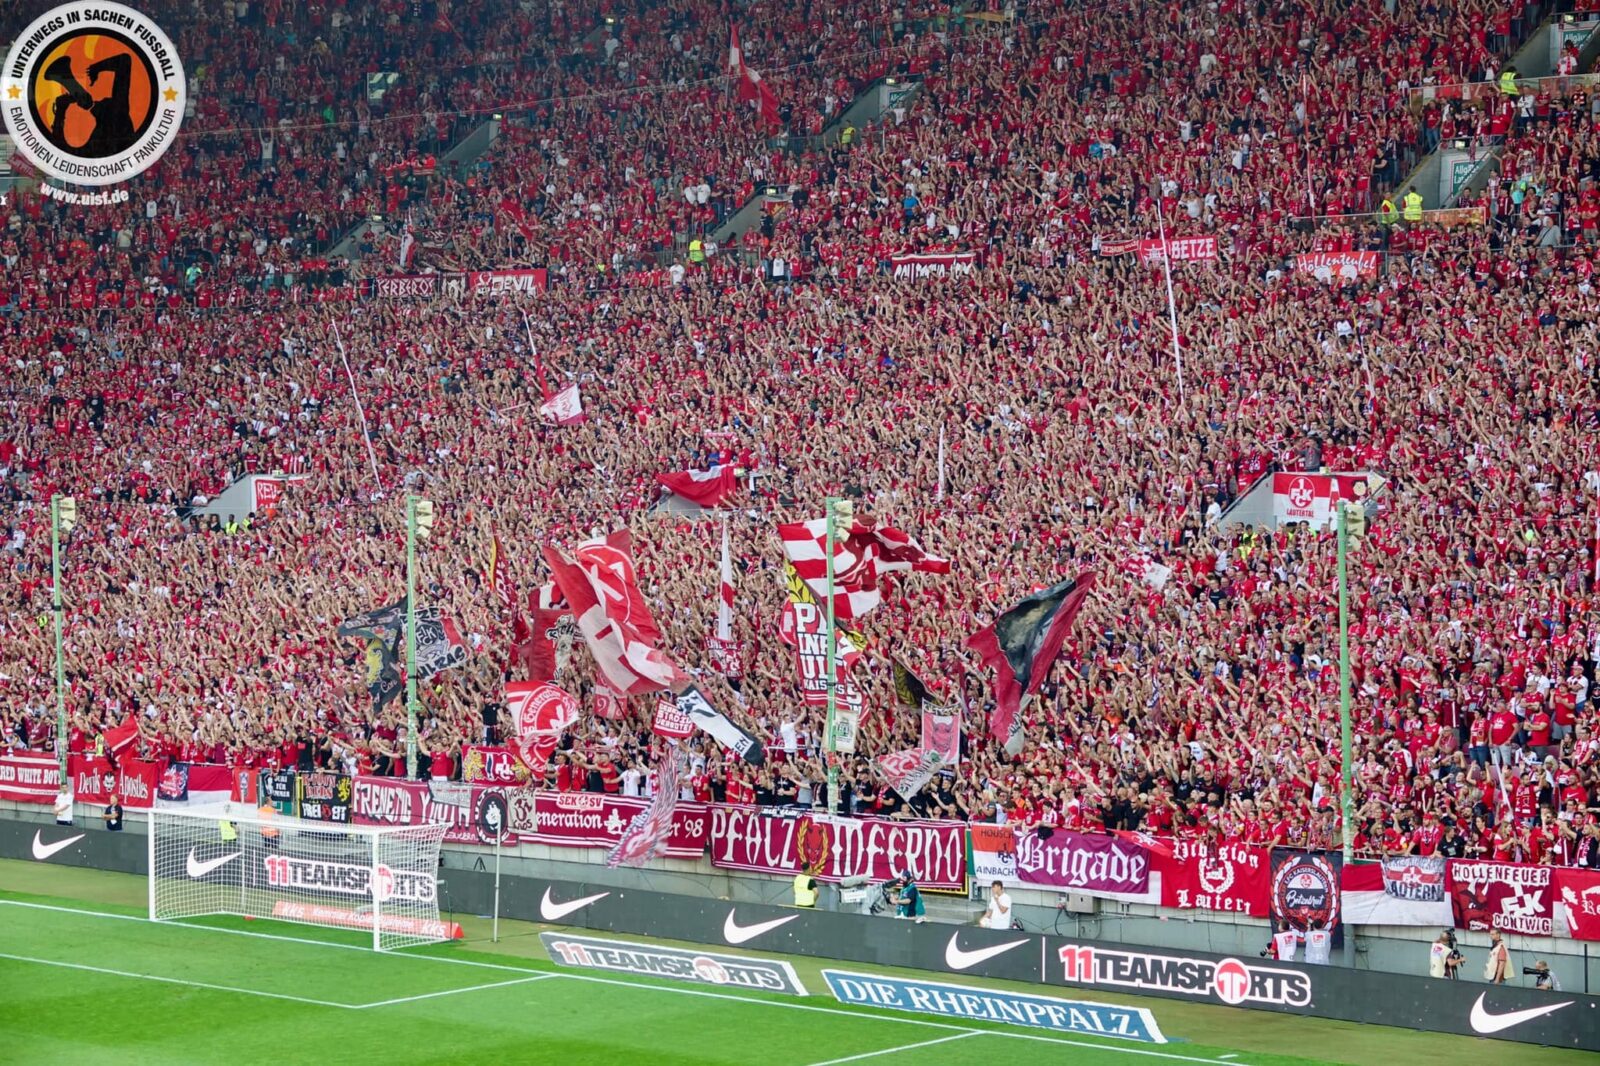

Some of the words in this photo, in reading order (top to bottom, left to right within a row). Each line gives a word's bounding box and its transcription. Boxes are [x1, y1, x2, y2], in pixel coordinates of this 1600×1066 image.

[1171, 238, 1214, 260] BETZE
[1297, 251, 1376, 272] Höllenteufel
[17, 767, 42, 784] WHITE
[119, 766, 149, 804] Apostles
[353, 781, 412, 823] FRENETIC
[558, 795, 577, 806] SEK
[589, 797, 602, 807] SV
[536, 811, 602, 829] eneration
[711, 808, 797, 869] PFALZ
[831, 822, 963, 882] INFERNO
[1172, 841, 1259, 869] Divsion
[1016, 833, 1146, 886] Brigade
[1493, 912, 1552, 934] CONTWIG
[836, 978, 902, 1007] DIE
[906, 985, 1140, 1037] RHEINPFALZ
